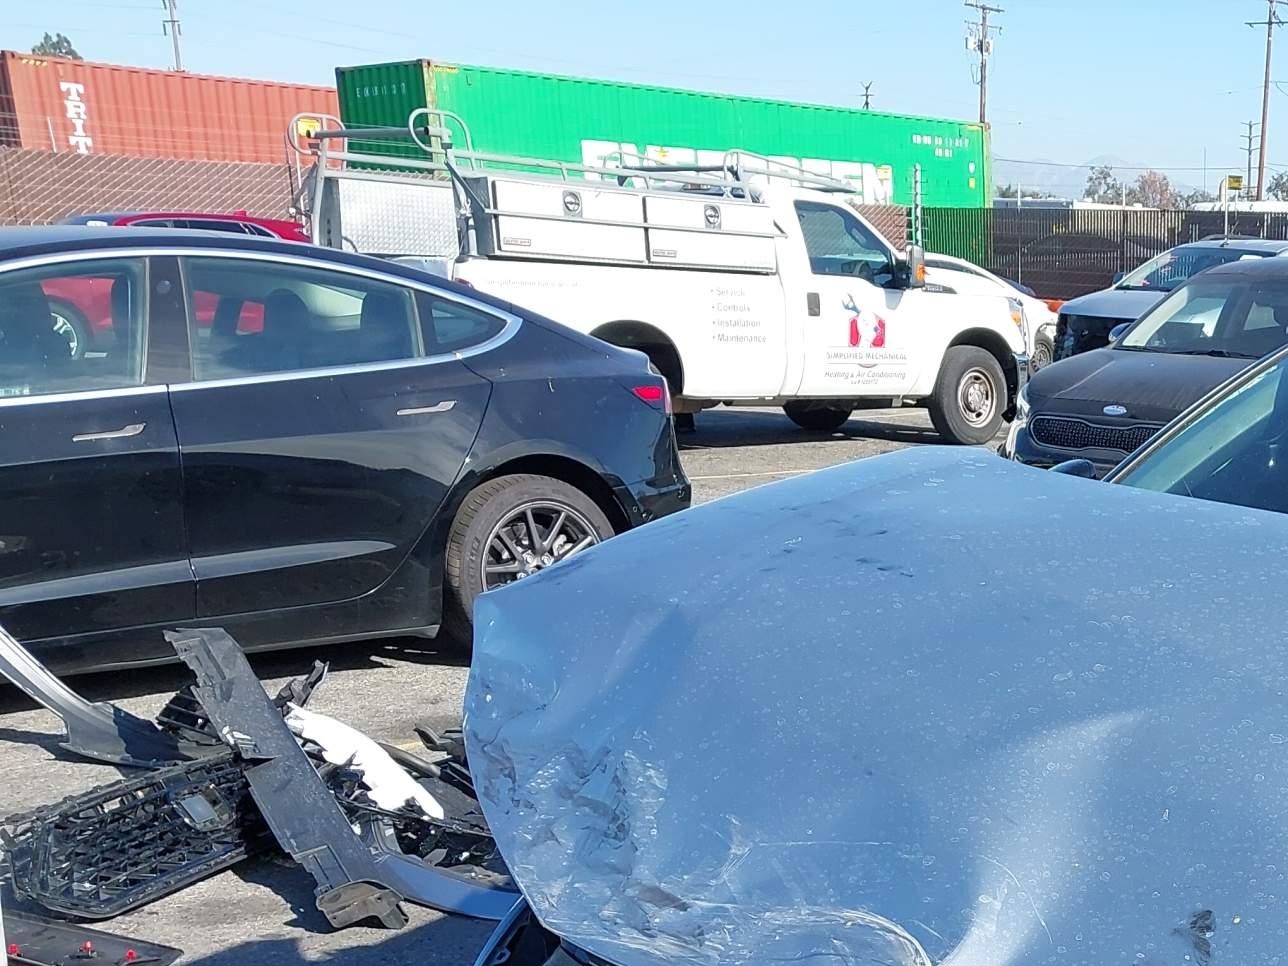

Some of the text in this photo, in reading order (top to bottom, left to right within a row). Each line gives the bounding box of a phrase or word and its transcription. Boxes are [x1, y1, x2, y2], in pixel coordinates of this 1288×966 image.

[717, 302, 751, 312] Controls
[717, 318, 761, 328] Installation
[718, 333, 767, 343] Maintenance
[826, 352, 908, 361] SIMPLIFIED MECHANICAL
[824, 370, 849, 379] Heating
[856, 370, 865, 378] Air
[867, 370, 906, 380] Conditioning
